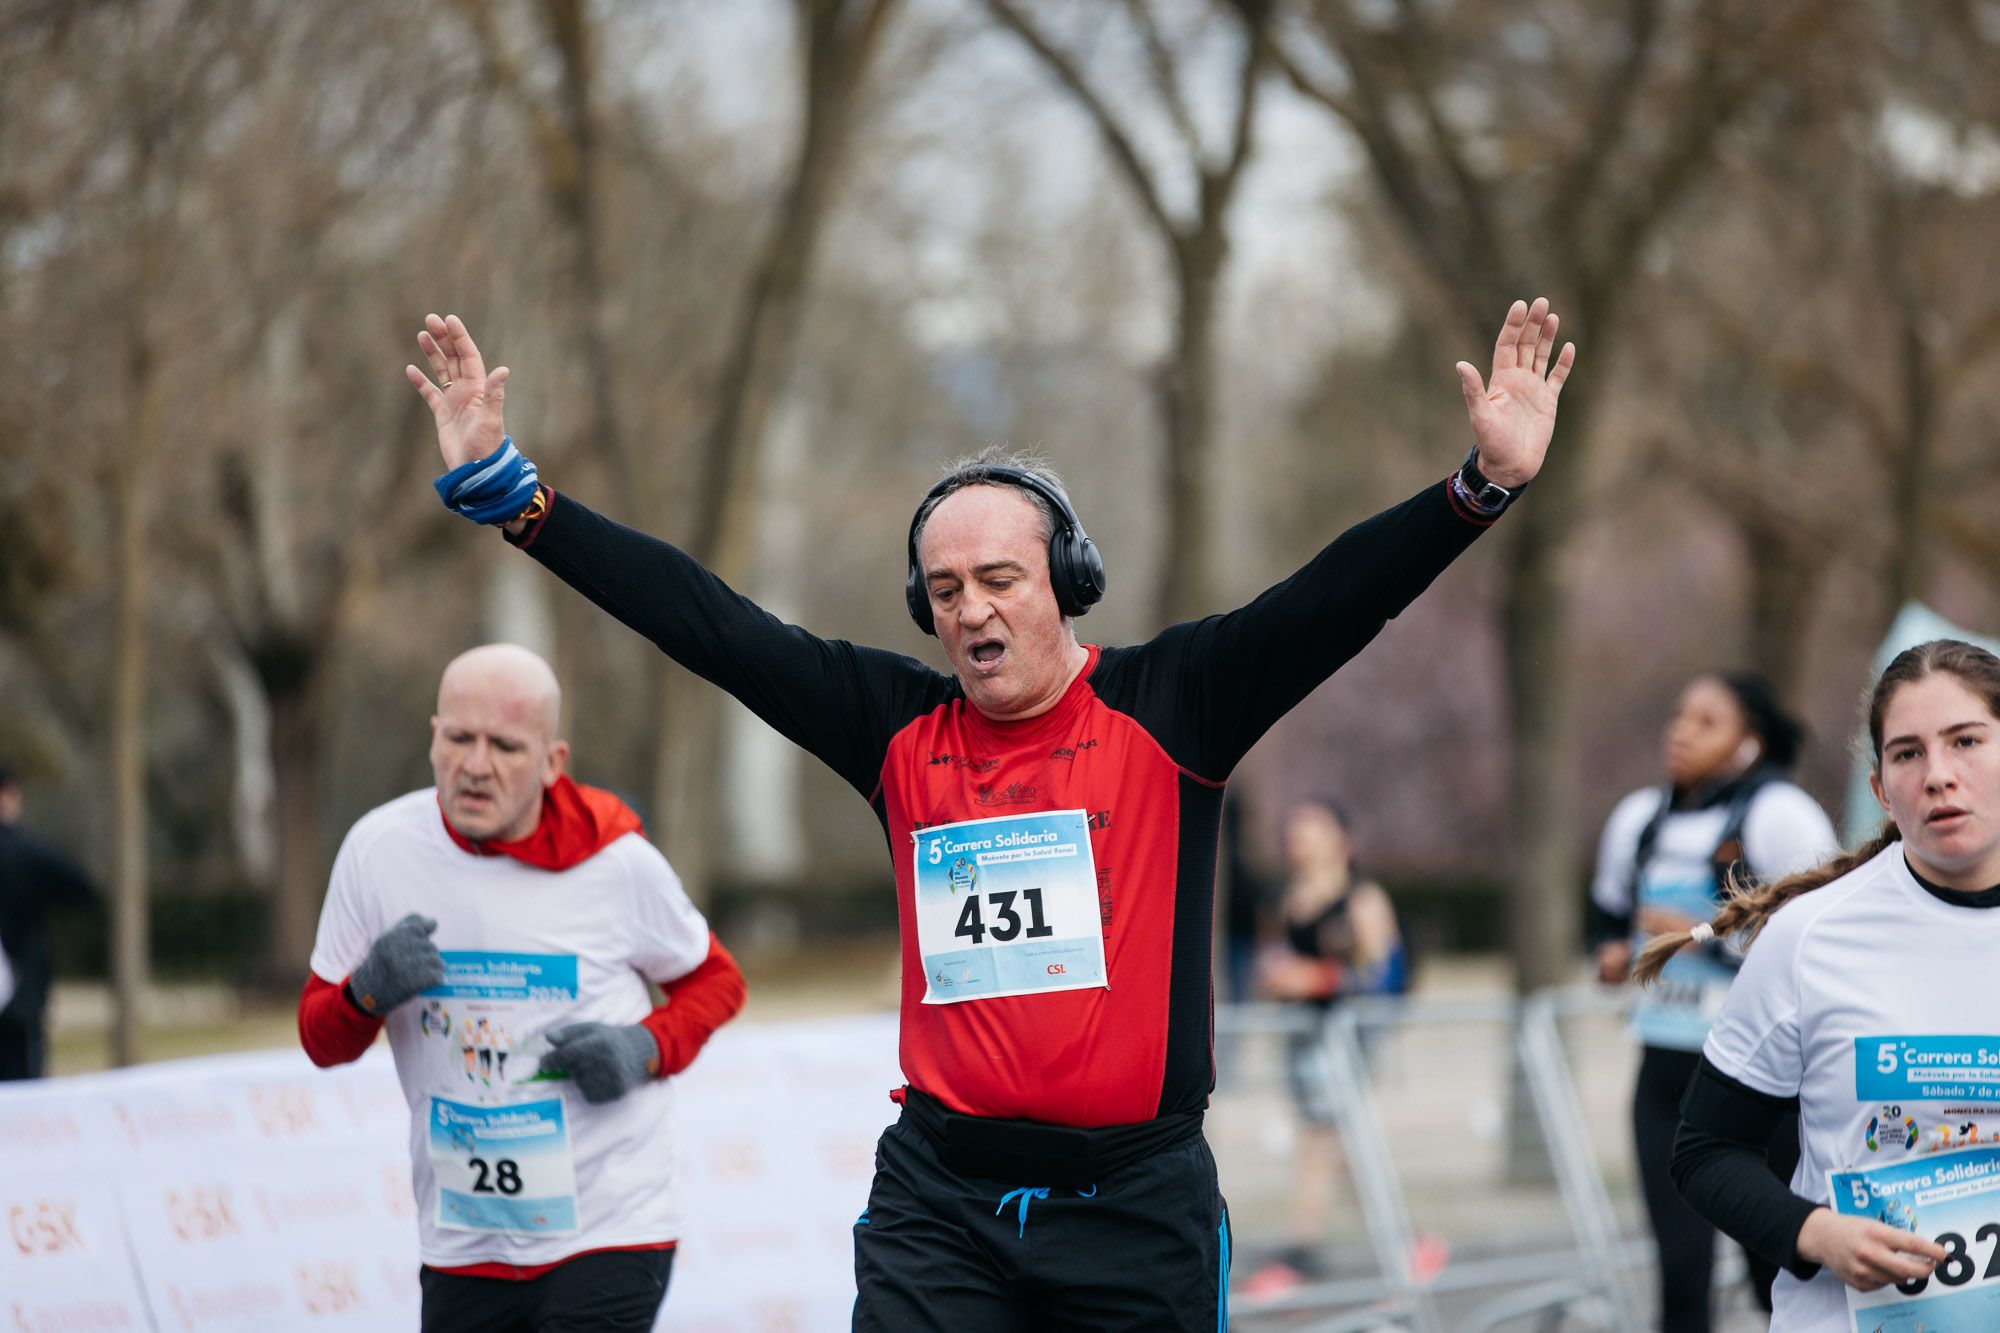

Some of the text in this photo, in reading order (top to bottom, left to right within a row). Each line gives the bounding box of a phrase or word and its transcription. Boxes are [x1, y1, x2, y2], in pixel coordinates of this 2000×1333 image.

[944, 840, 992, 854] Carrera
[995, 830, 1058, 848] Solidaria
[1011, 852, 1022, 861] por
[1033, 848, 1052, 857] Salud
[954, 887, 1053, 944] 431
[1047, 963, 1067, 975] CSL
[1903, 1048, 1972, 1065] Carrera
[1952, 1072, 1966, 1080] por
[1969, 1070, 1977, 1078] la
[1922, 1084, 1965, 1097] Sábado
[1968, 1085, 1976, 1098] 7
[1978, 1085, 1992, 1098] de
[469, 1157, 523, 1195] 28
[1870, 1175, 1932, 1199] Carrera
